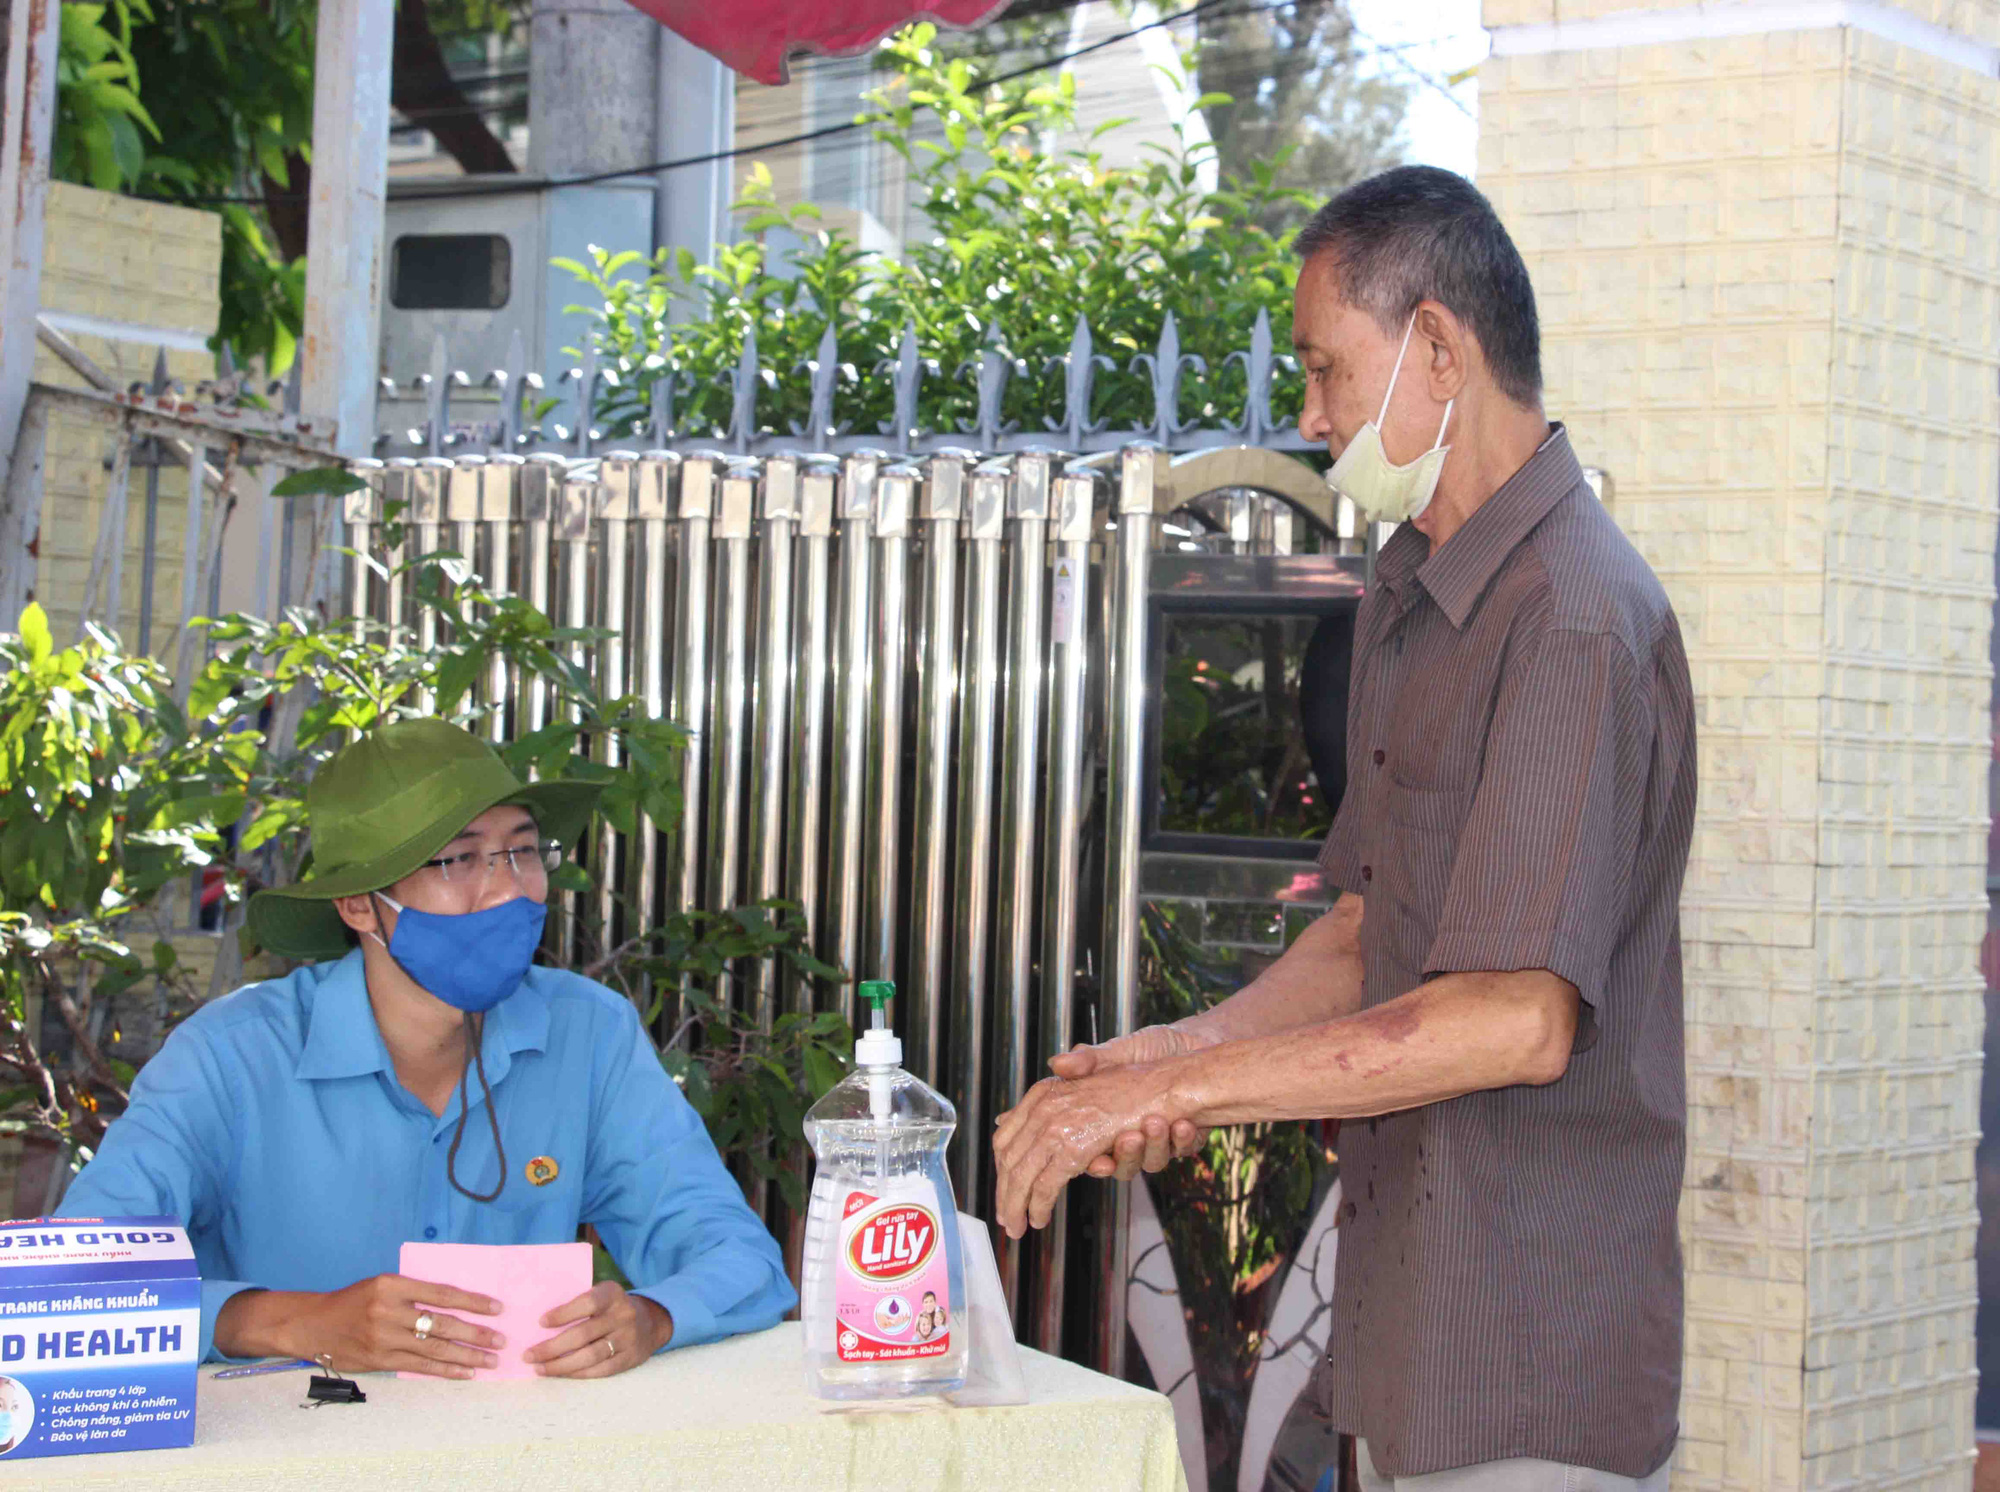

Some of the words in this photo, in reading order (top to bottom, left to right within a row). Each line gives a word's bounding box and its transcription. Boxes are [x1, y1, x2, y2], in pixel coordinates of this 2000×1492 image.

[876, 1216, 890, 1226] Gel
[906, 1211, 919, 1221] tay
[75, 1232, 176, 1245] GOLD
[861, 1221, 930, 1265] Lily
[867, 1262, 883, 1272] Hand
[883, 1260, 908, 1269] sanitizer
[106, 1288, 159, 1309] KHUẨN
[37, 1325, 182, 1360] HEALTH
[862, 1351, 875, 1359] tay
[52, 1387, 83, 1400] Khẩu
[86, 1388, 117, 1398] trang
[119, 1386, 126, 1396] 4
[128, 1385, 147, 1396] lớp
[52, 1405, 71, 1416] Lọc
[74, 1402, 110, 1413] không
[112, 1399, 131, 1410] khí
[141, 1396, 177, 1408] nhiễm
[124, 1412, 154, 1425] giảm
[156, 1411, 171, 1421] tia
[174, 1409, 191, 1420] UV
[50, 1432, 73, 1442] Bảo
[76, 1430, 88, 1442] vệ
[91, 1429, 109, 1439] làn
[111, 1428, 127, 1438] da
